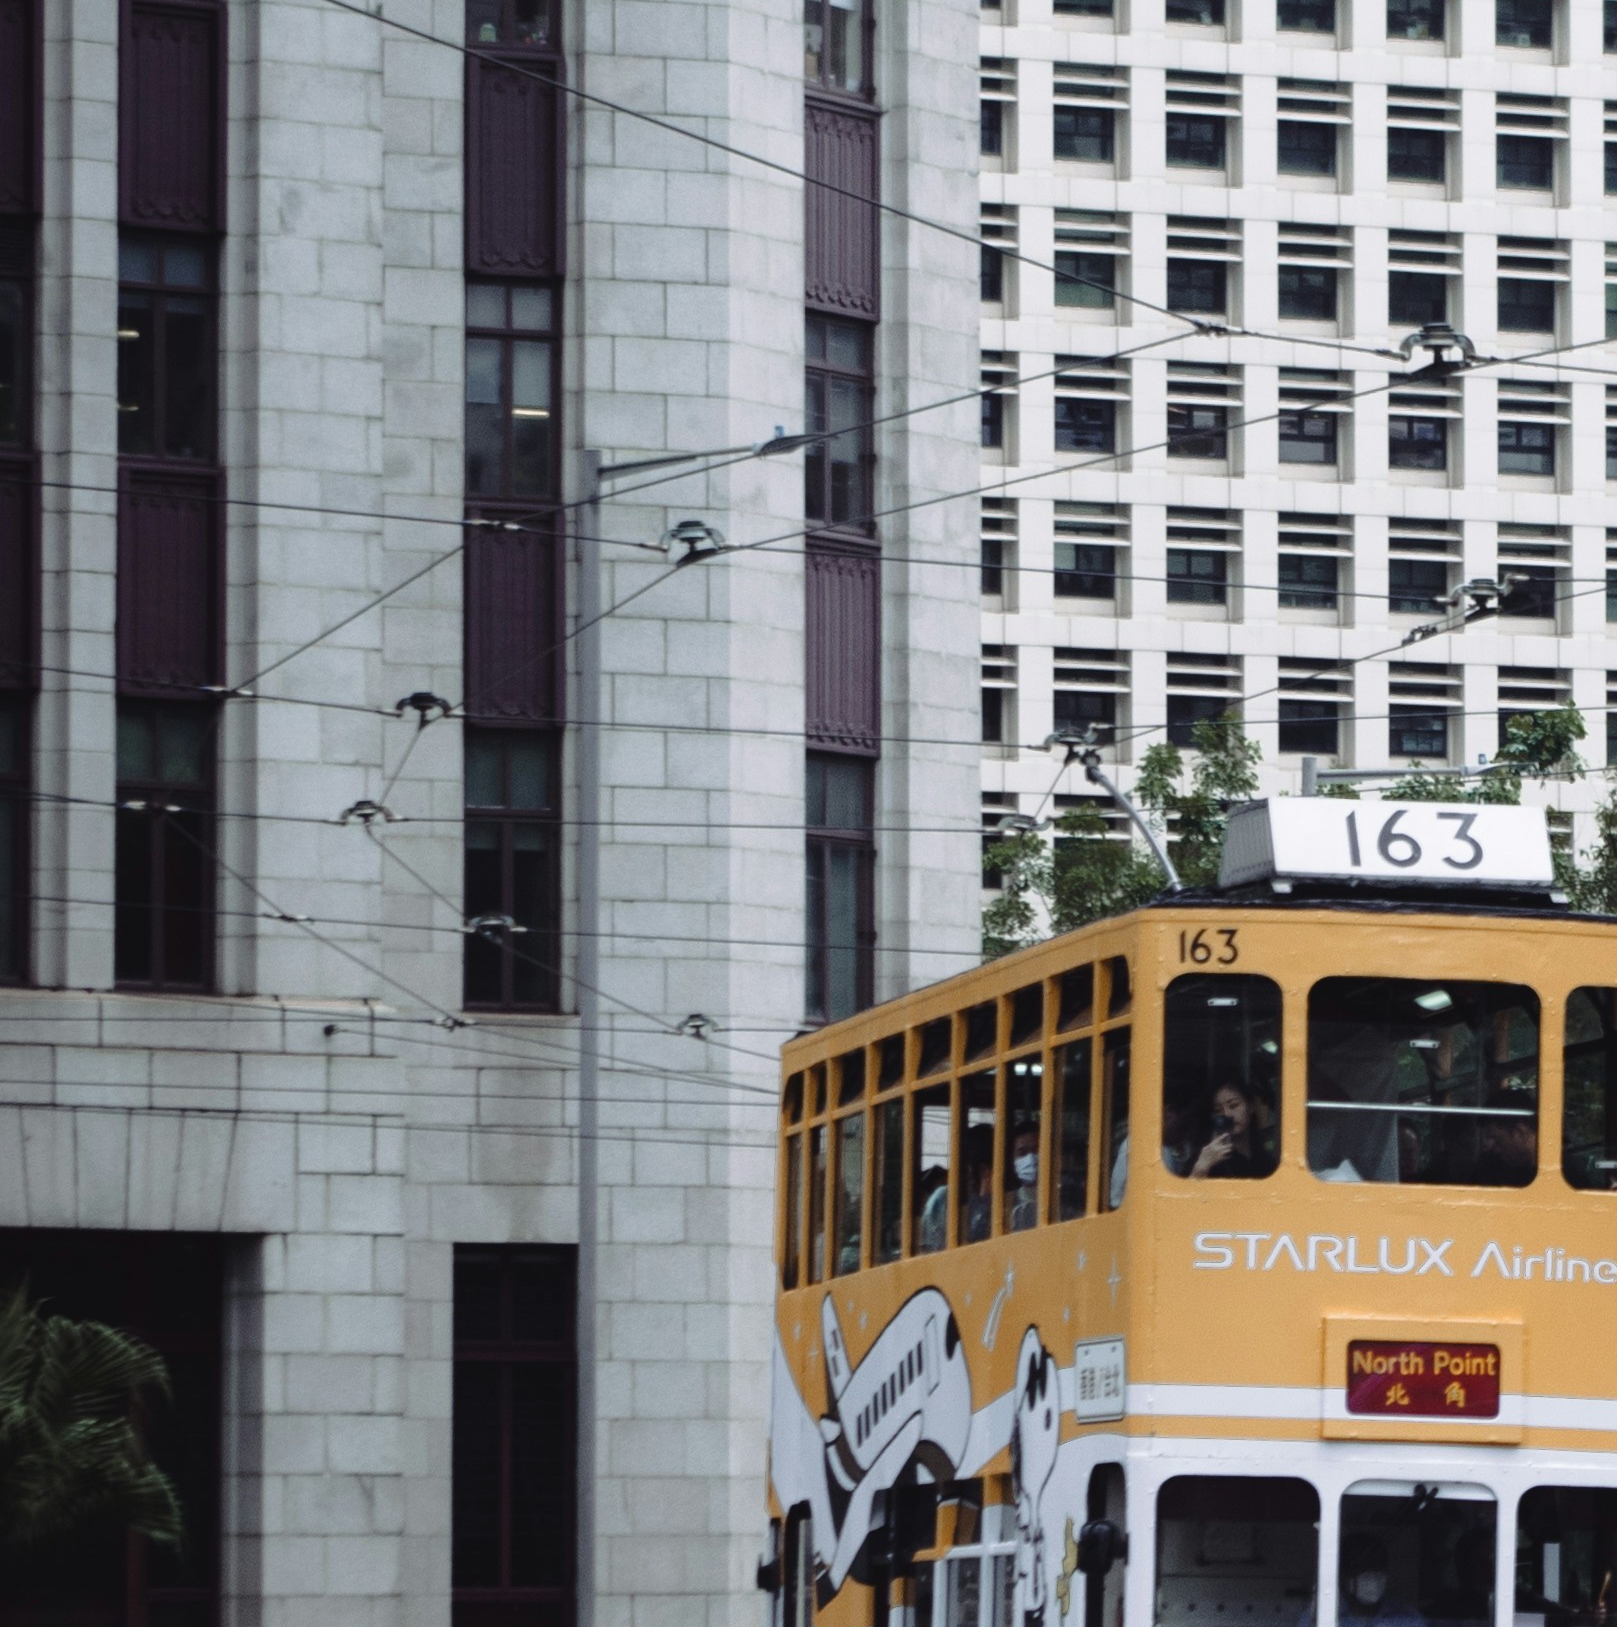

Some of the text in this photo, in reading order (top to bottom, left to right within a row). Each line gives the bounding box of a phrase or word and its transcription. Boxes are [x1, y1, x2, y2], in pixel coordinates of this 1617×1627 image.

[1344, 809, 1486, 870] 163
[1178, 929, 1240, 965] 163
[1193, 1232, 1454, 1278] STARLUX
[1352, 1350, 1497, 1377] North Point
